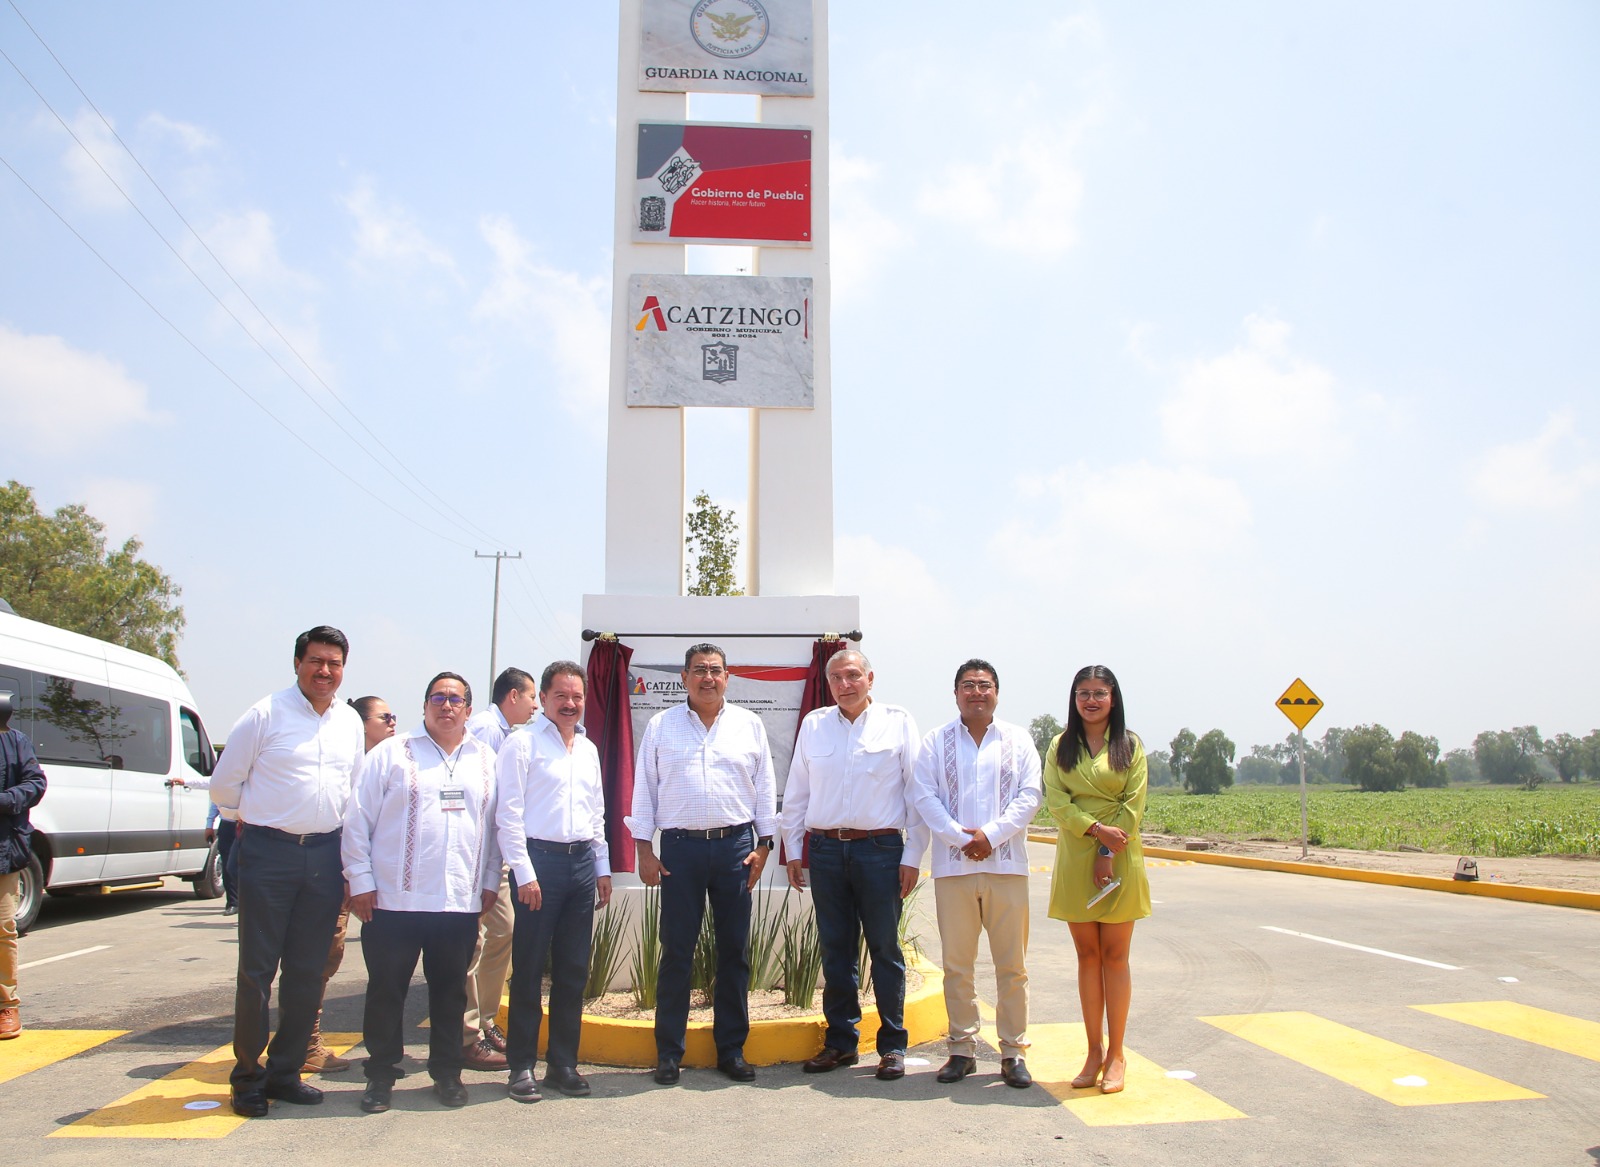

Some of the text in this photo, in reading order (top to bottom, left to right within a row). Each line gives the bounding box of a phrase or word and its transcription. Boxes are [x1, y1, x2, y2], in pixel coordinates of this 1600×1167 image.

[645, 67, 808, 83] GUARDIA NACIONAL
[691, 187, 804, 201] Gobierno de Puebla
